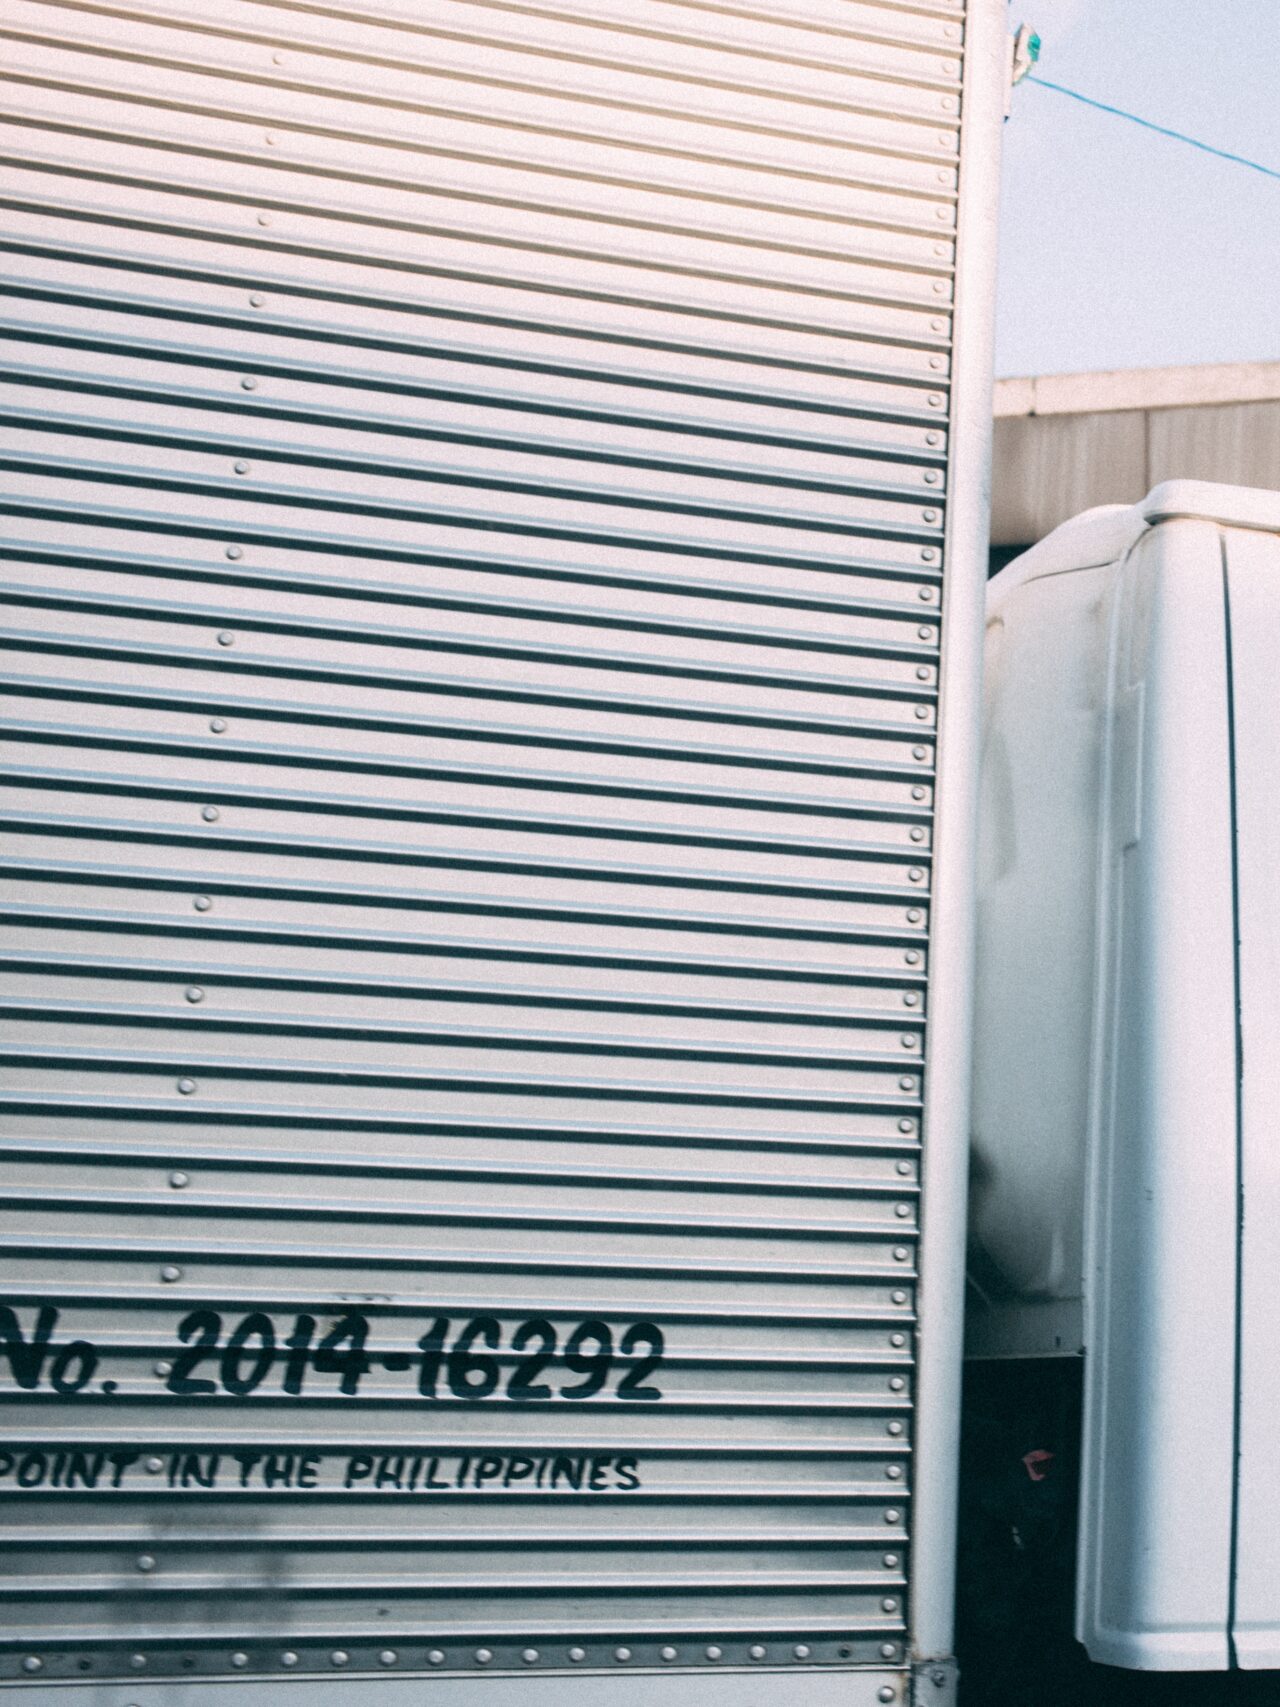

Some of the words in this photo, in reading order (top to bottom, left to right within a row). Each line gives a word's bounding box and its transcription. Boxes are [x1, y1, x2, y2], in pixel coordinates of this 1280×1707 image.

[0, 1305, 118, 1394] No.
[165, 1310, 665, 1400] 2014-16292
[166, 1453, 219, 1488] IN
[233, 1453, 322, 1489] THE
[344, 1455, 641, 1490] PHILIPPINES
